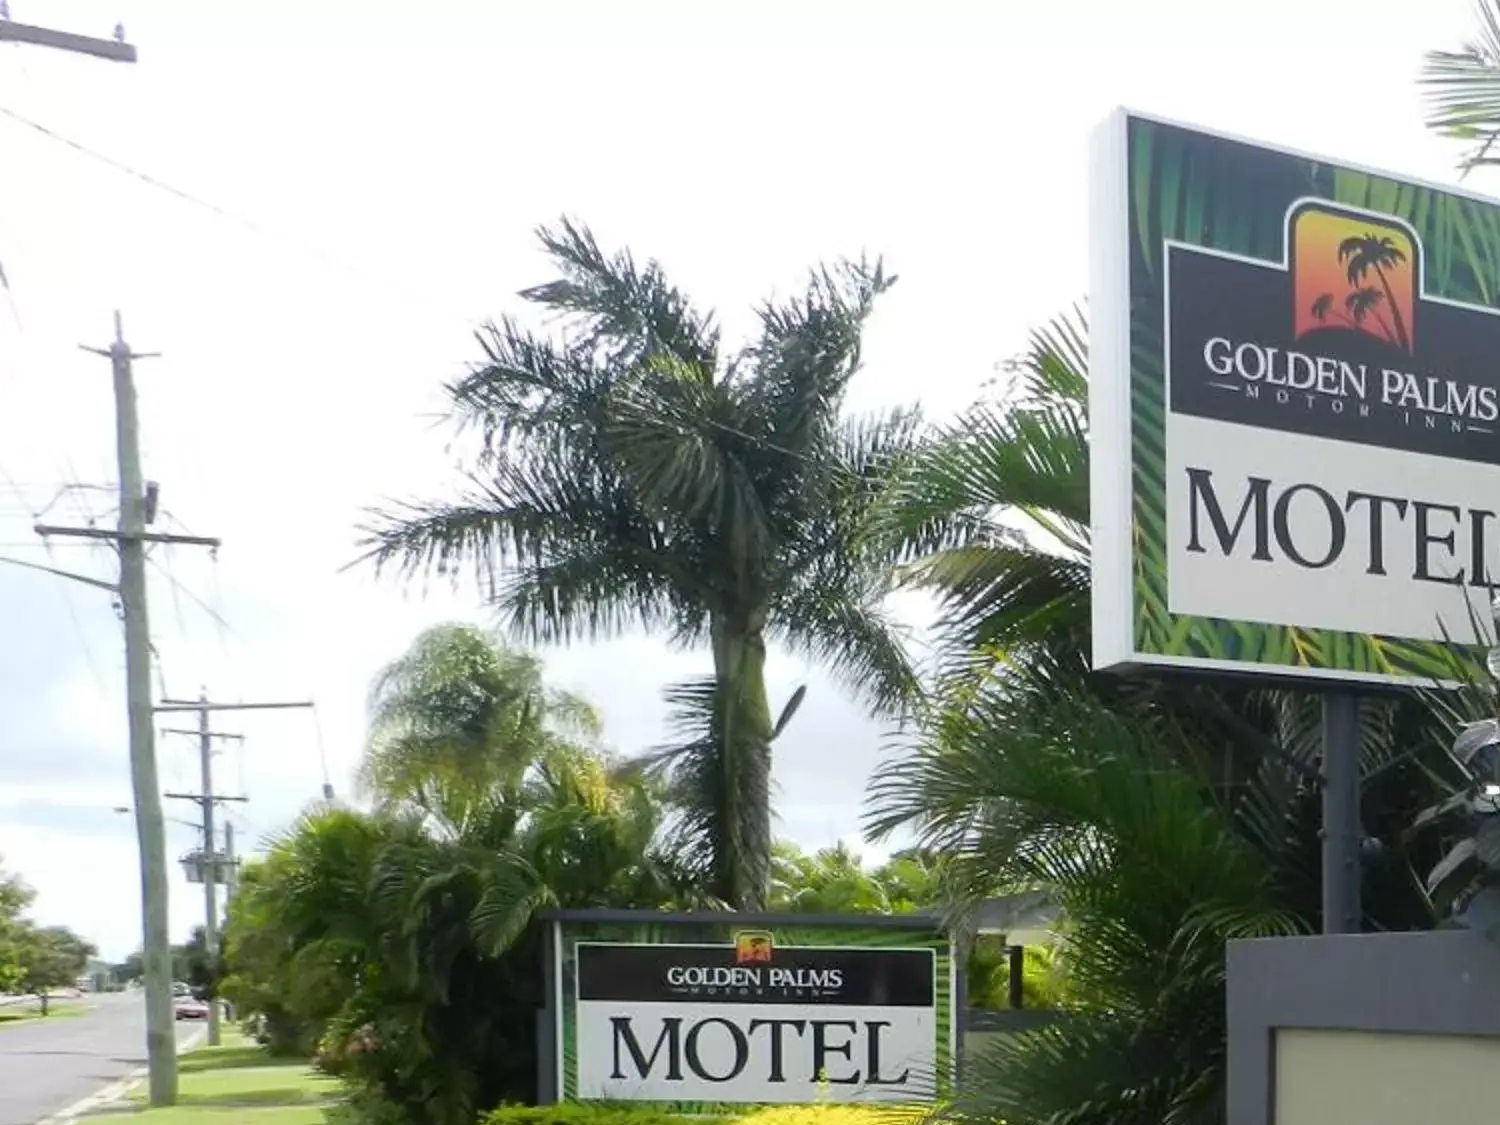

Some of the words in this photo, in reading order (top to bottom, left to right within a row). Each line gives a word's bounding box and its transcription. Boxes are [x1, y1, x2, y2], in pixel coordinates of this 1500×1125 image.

[1203, 336, 1367, 399] GOLDEN
[1381, 367, 1499, 422] PALMS
[1245, 384, 1369, 418] MOTOR
[1404, 411, 1462, 433] INN
[667, 966, 761, 987] GOLDEN
[769, 968, 843, 988] PALMS
[609, 1017, 910, 1085] MOTEL
